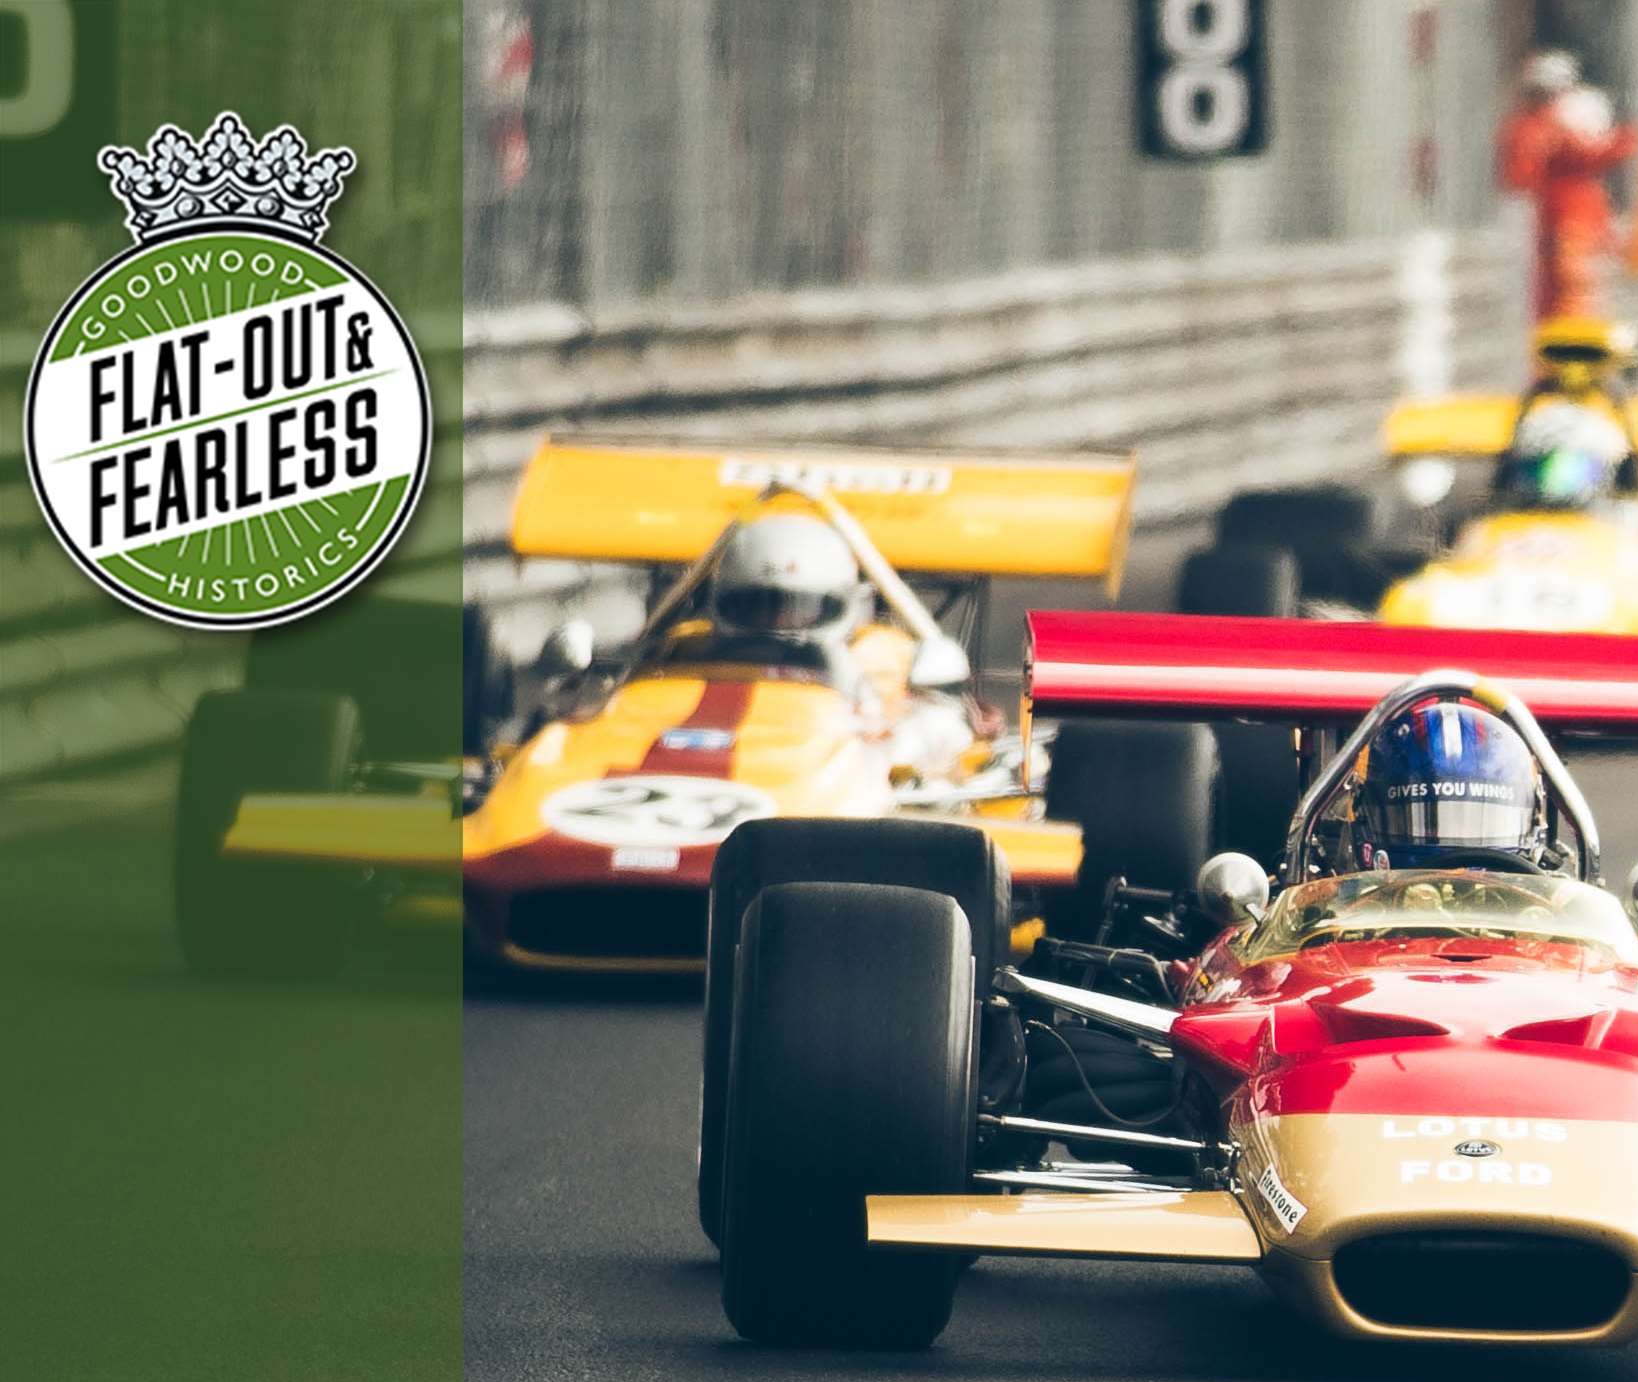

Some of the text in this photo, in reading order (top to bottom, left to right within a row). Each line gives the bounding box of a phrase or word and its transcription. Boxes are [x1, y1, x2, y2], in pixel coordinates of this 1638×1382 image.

[1387, 782, 1514, 801] GIVES YOU WINGS
[1382, 1118, 1569, 1142] LOTUS
[1400, 1160, 1553, 1185] FORD
